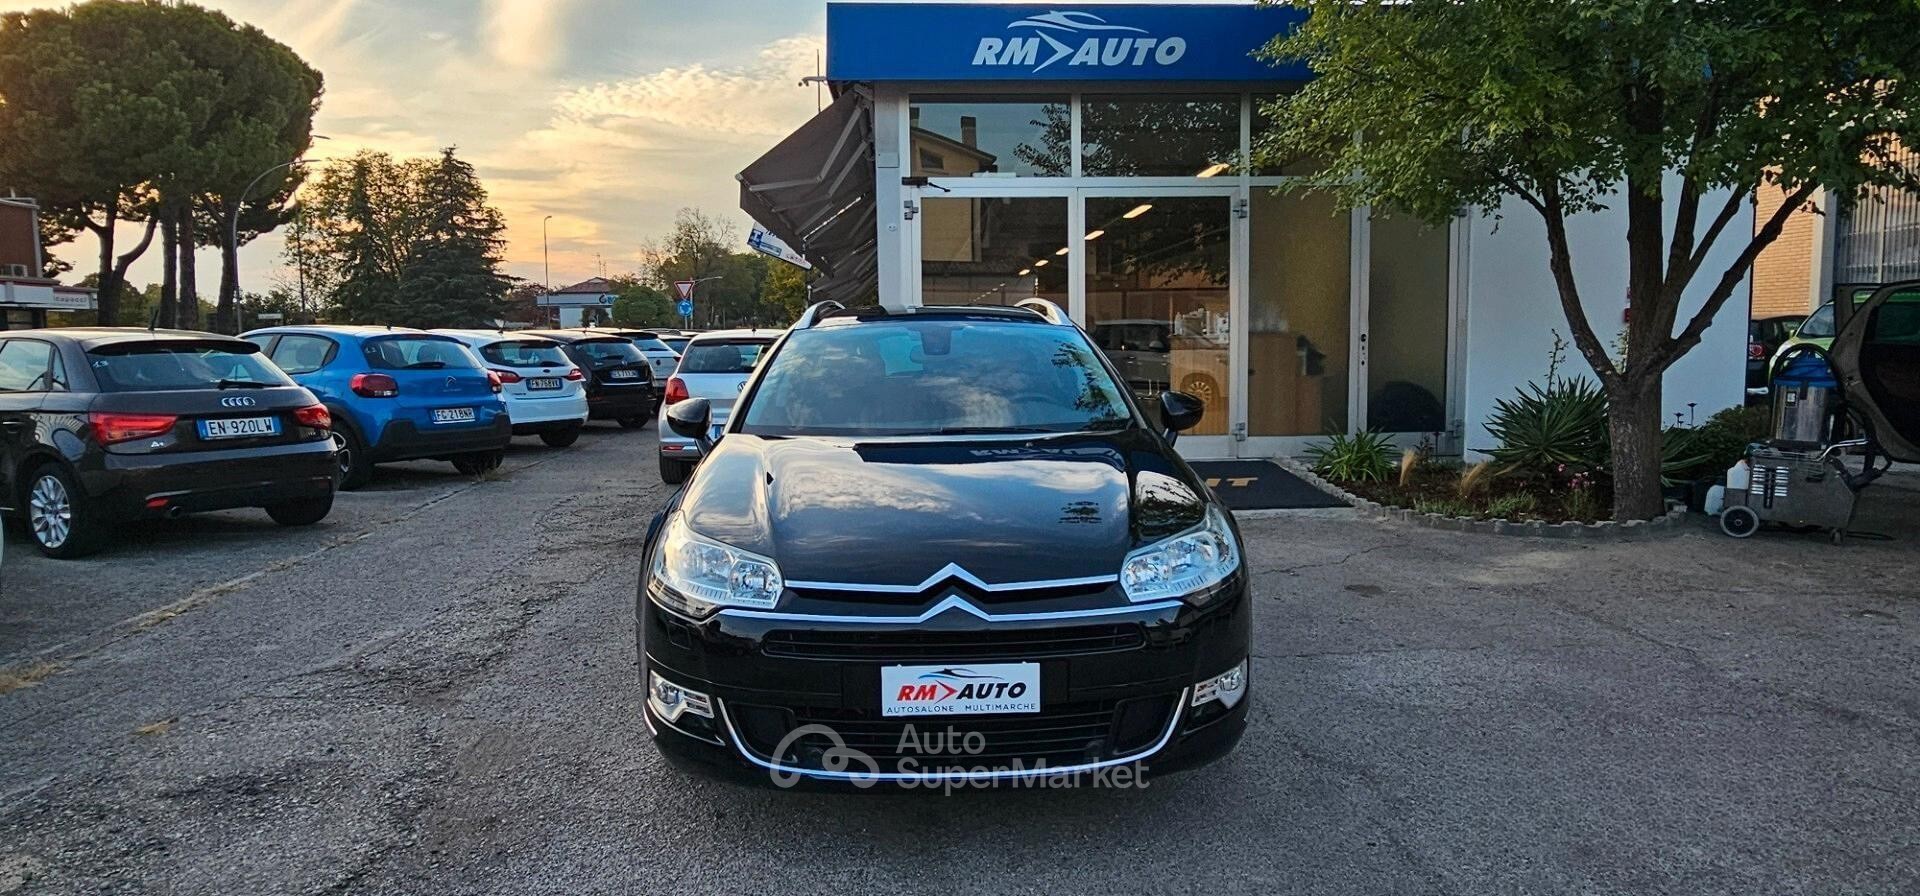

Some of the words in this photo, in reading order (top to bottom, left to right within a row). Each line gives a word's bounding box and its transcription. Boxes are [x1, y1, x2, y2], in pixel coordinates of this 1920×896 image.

[971, 37, 1040, 66] RM
[1068, 36, 1187, 66] AUTO
[209, 421, 227, 435] EN
[230, 418, 273, 434] 920LW
[896, 684, 938, 701] RM
[955, 681, 1027, 700] AUTO
[886, 705, 954, 714] AUTOSALONE
[965, 703, 1036, 712] MULTIMARCHE
